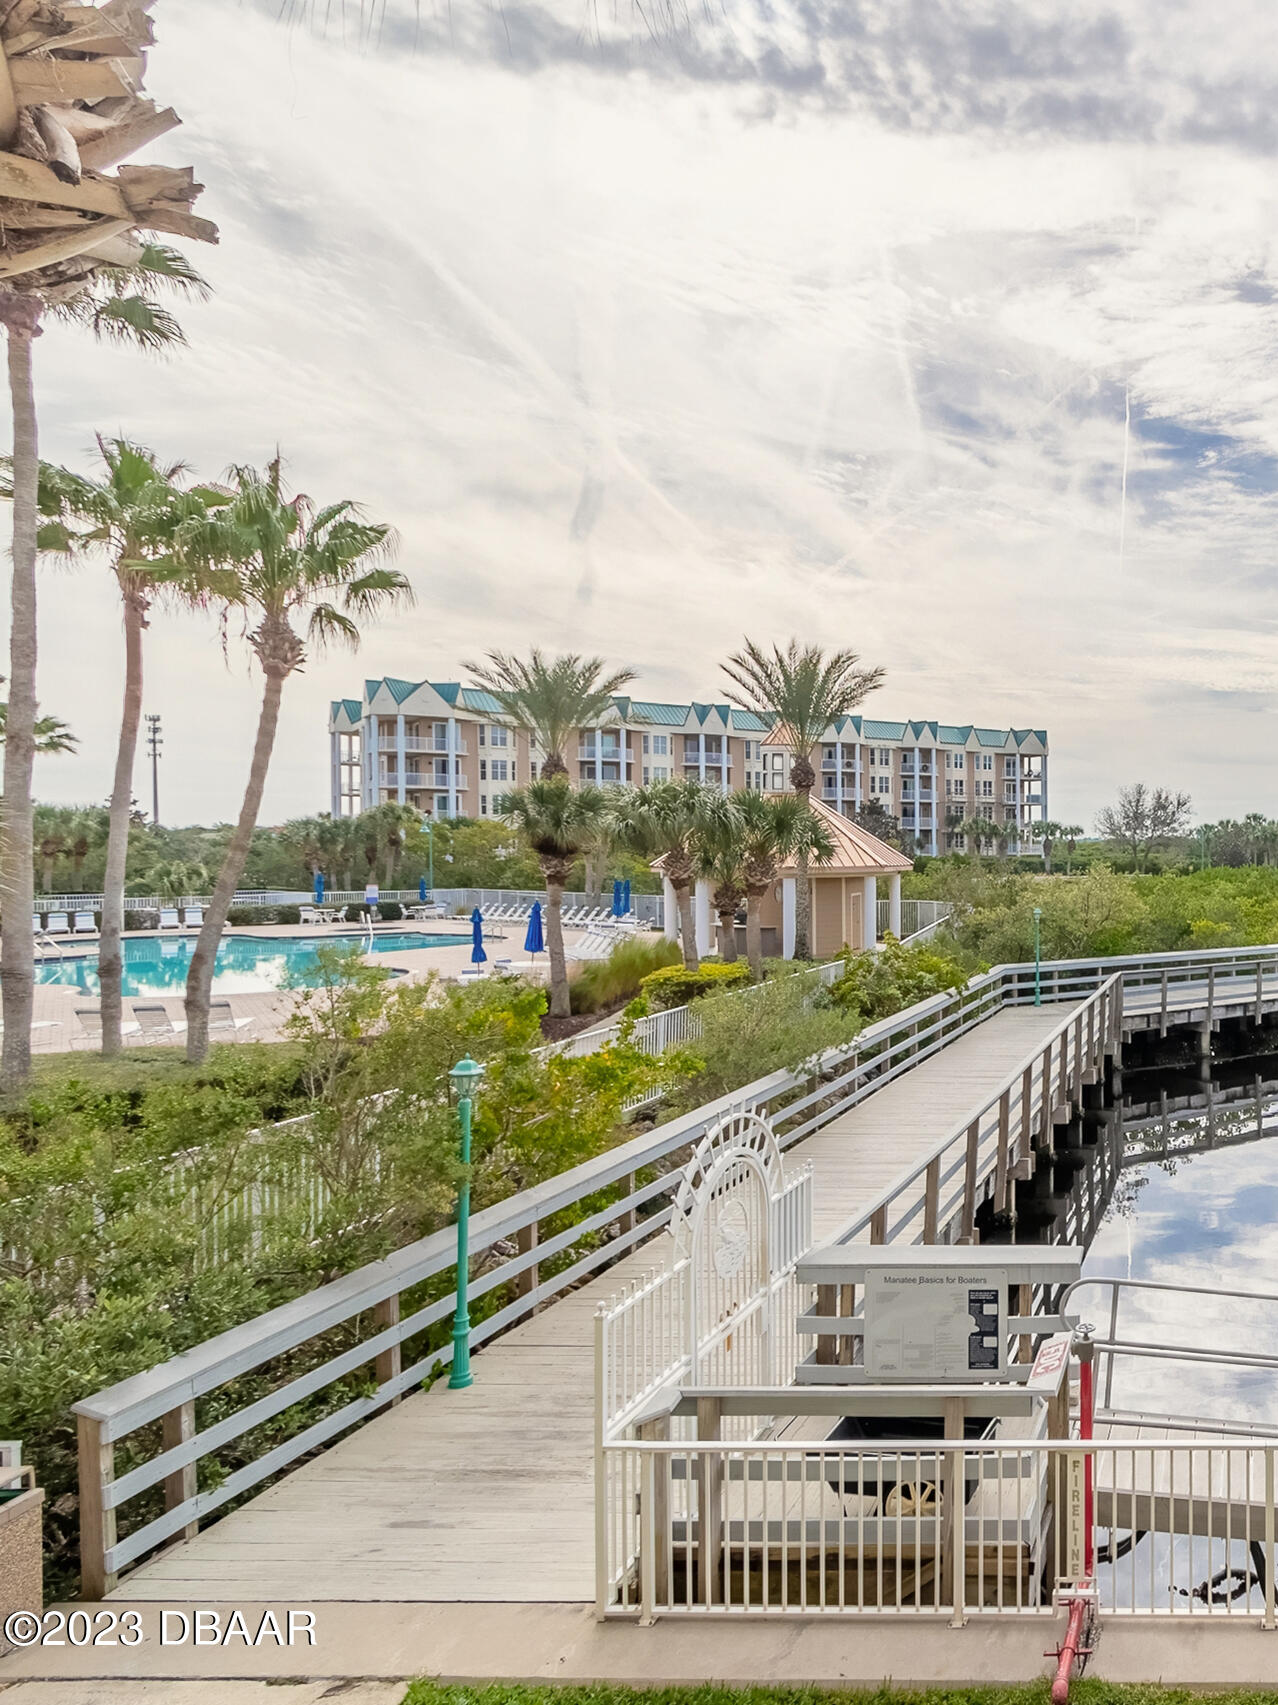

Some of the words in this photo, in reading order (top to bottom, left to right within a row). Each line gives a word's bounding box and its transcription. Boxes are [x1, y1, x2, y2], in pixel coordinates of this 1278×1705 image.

[883, 1275, 917, 1284] Manatee
[918, 1275, 944, 1285] Basics
[945, 1275, 956, 1284] for
[957, 1275, 987, 1284] Boaters
